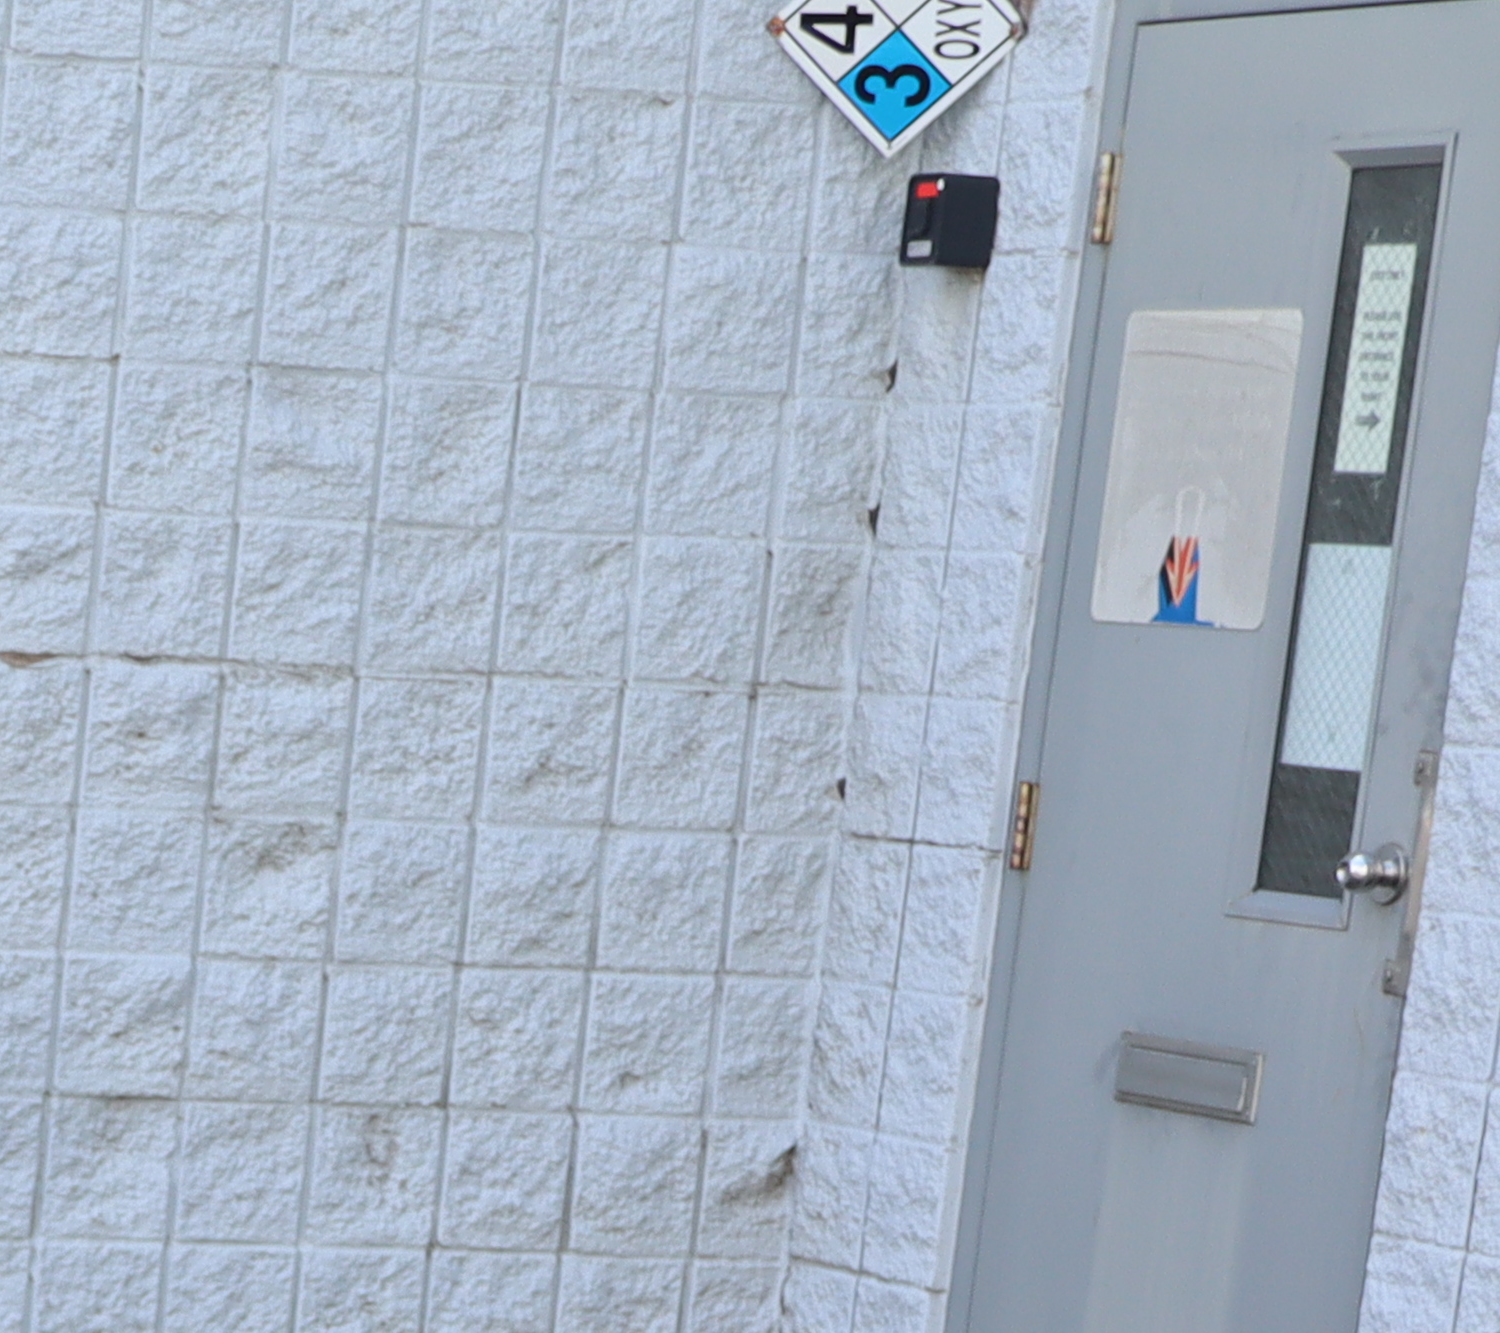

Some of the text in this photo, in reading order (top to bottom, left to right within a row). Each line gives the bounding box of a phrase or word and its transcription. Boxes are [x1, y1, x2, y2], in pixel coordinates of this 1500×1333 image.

[800, 5, 873, 54] 4
[934, 0, 983, 60] OXY
[854, 64, 931, 107] 3
